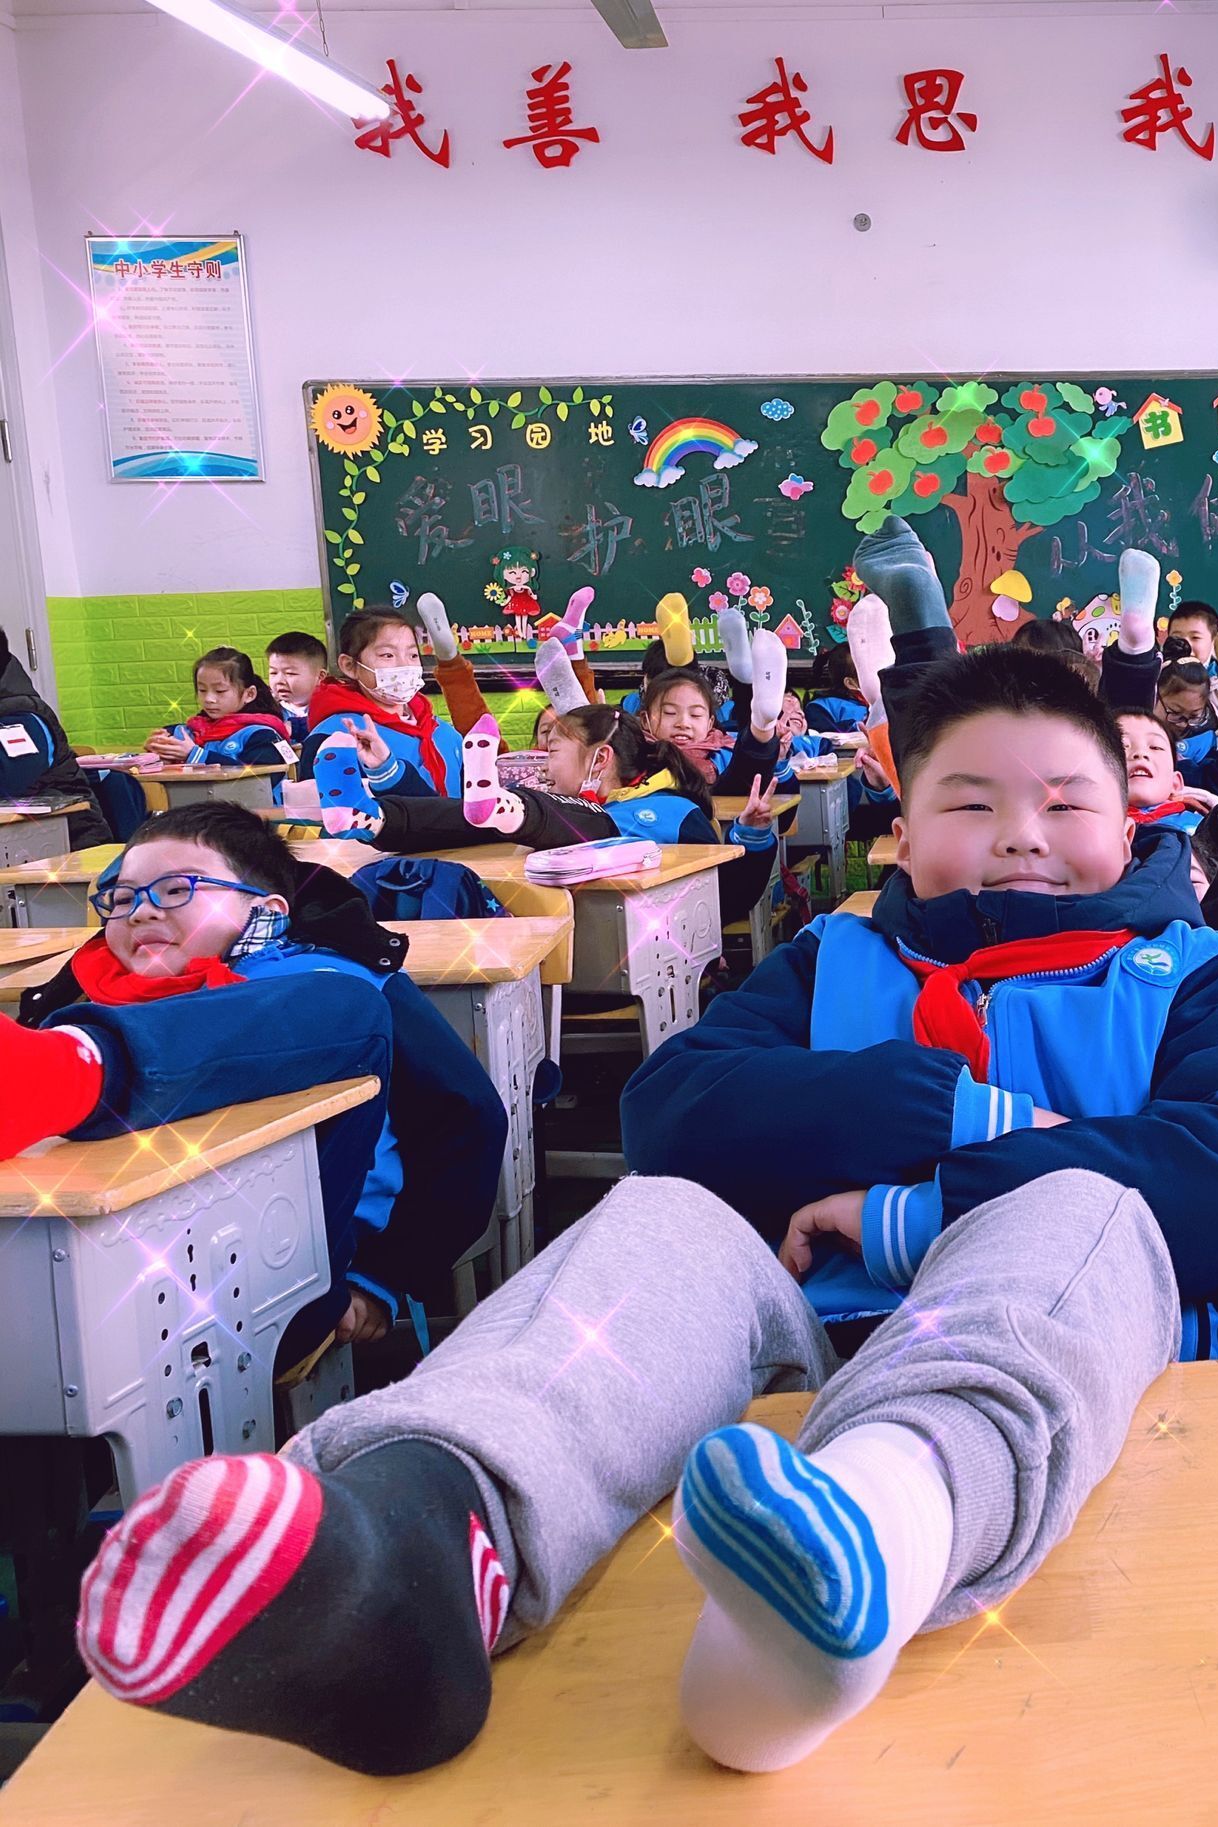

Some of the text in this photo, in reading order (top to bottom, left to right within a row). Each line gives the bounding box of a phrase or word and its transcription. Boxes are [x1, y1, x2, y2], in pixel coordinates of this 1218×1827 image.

[351, 58, 600, 169] 我善
[738, 56, 978, 165] 我思
[113, 259, 223, 280] 中小学生守则
[422, 421, 614, 455] 学习园地
